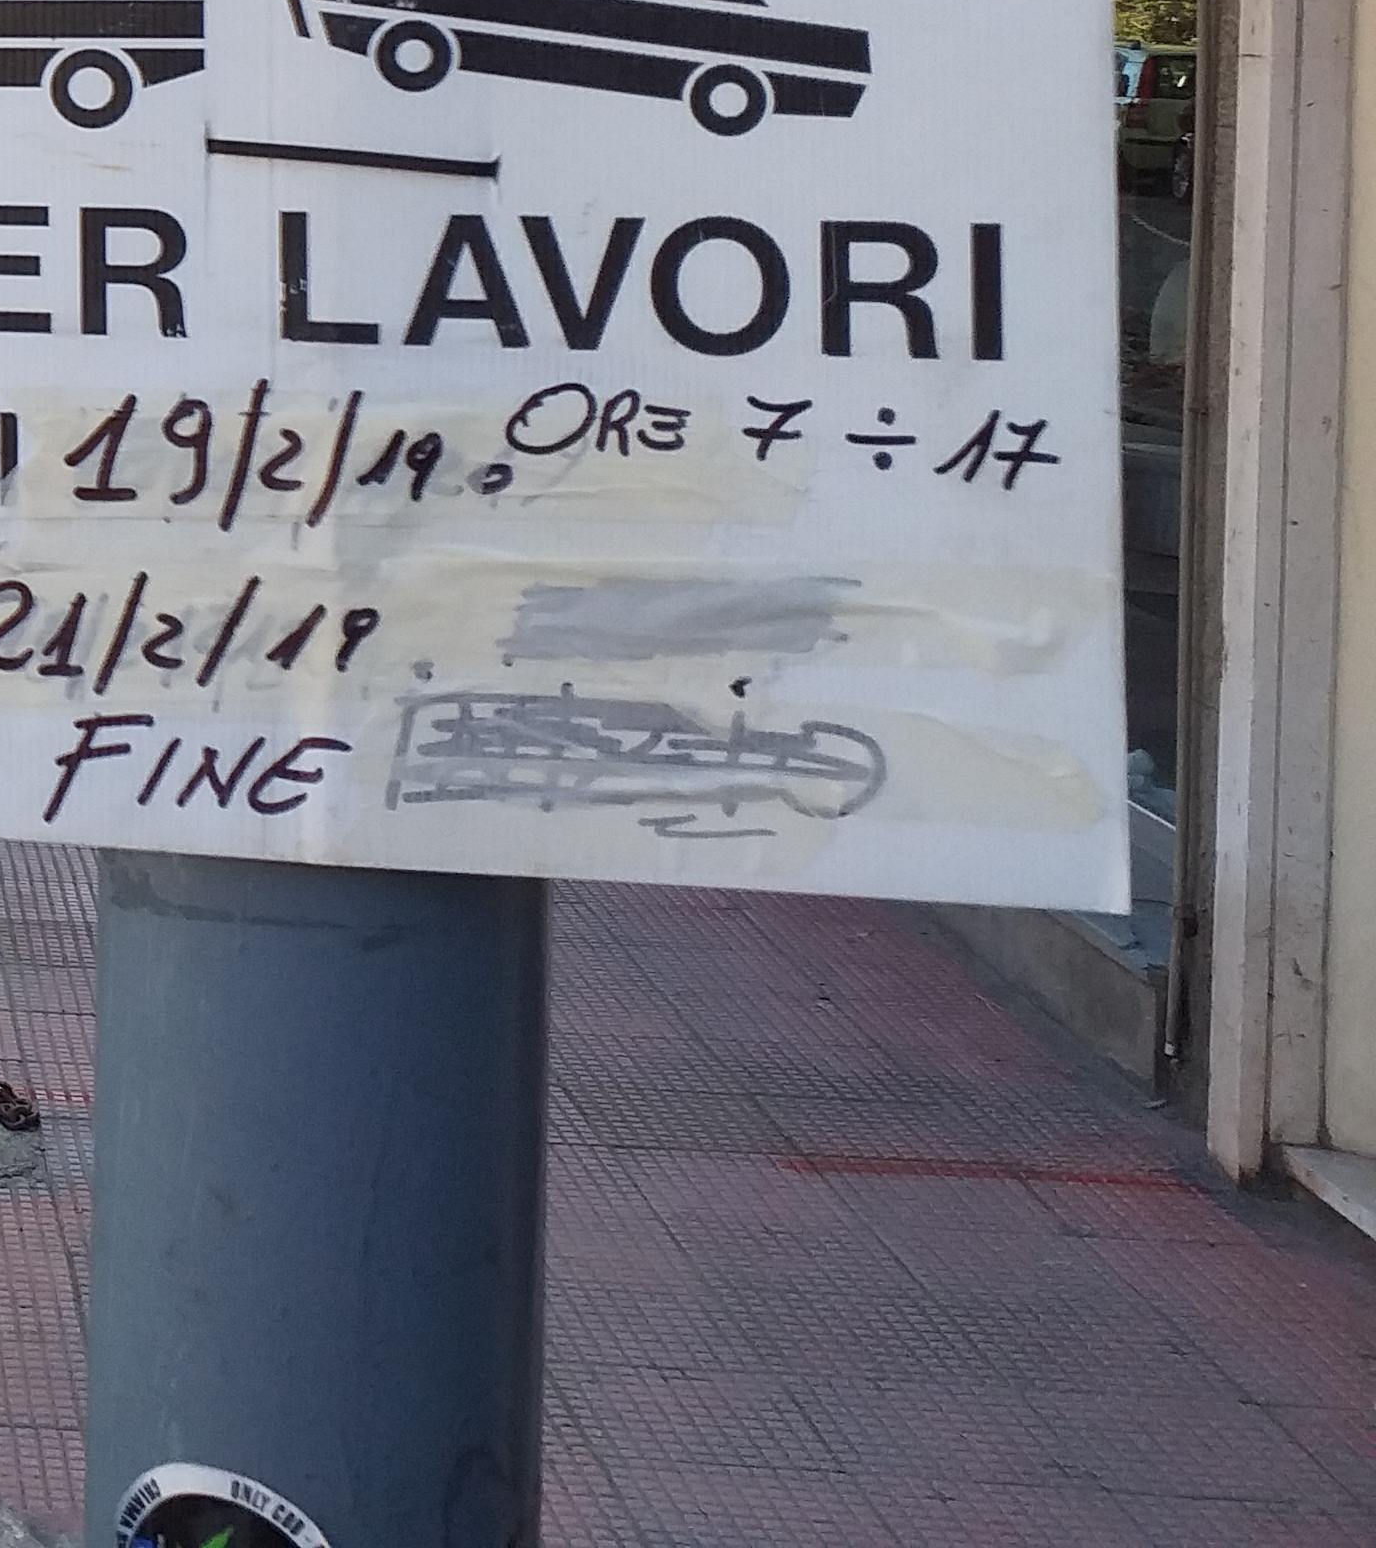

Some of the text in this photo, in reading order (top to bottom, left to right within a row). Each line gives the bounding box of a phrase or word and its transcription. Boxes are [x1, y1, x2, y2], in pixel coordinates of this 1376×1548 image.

[279, 211, 1005, 362] LAVORI
[505, 382, 691, 457] ORE
[742, 396, 812, 461] 7
[933, 410, 1060, 490] 17
[46, 712, 352, 821] FINE
